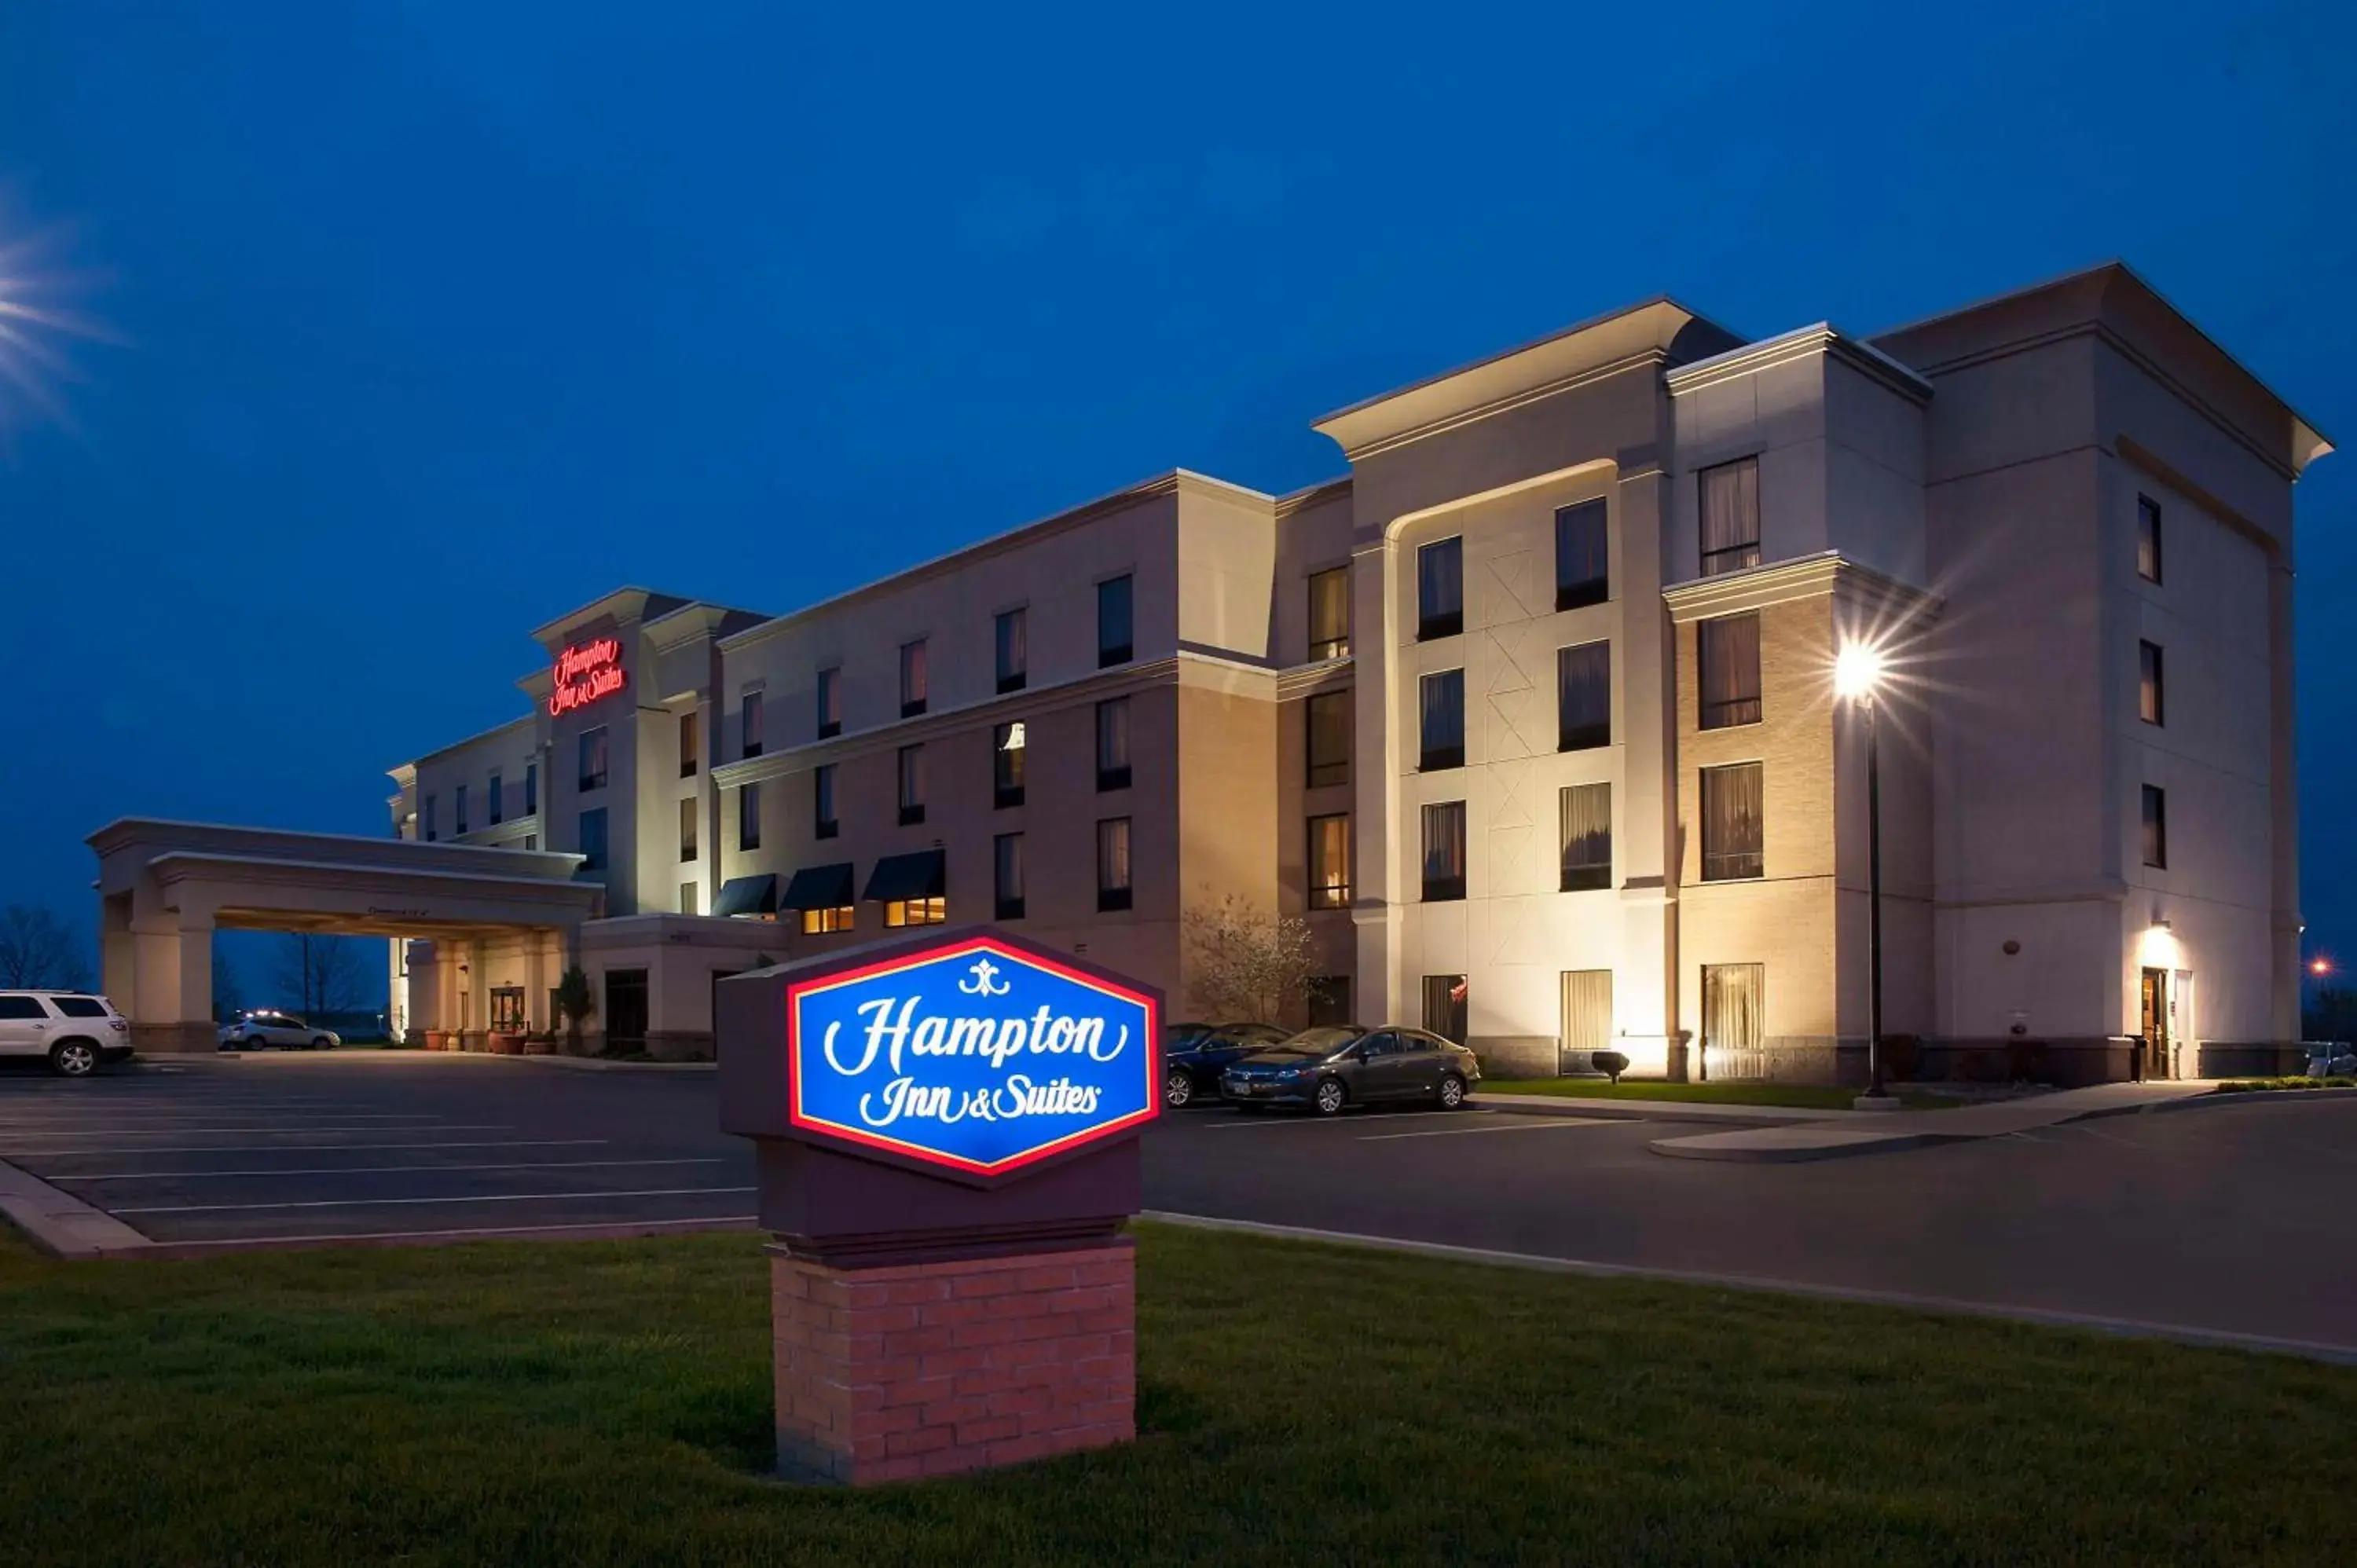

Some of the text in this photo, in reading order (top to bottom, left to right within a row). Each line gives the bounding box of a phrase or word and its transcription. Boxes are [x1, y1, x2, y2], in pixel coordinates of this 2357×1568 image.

[555, 640, 618, 687] Hampton
[550, 684, 579, 716] Inn
[587, 666, 621, 699] Suites
[824, 995, 1128, 1075] Hampton
[860, 1074, 1101, 1127] Inn & Suites
